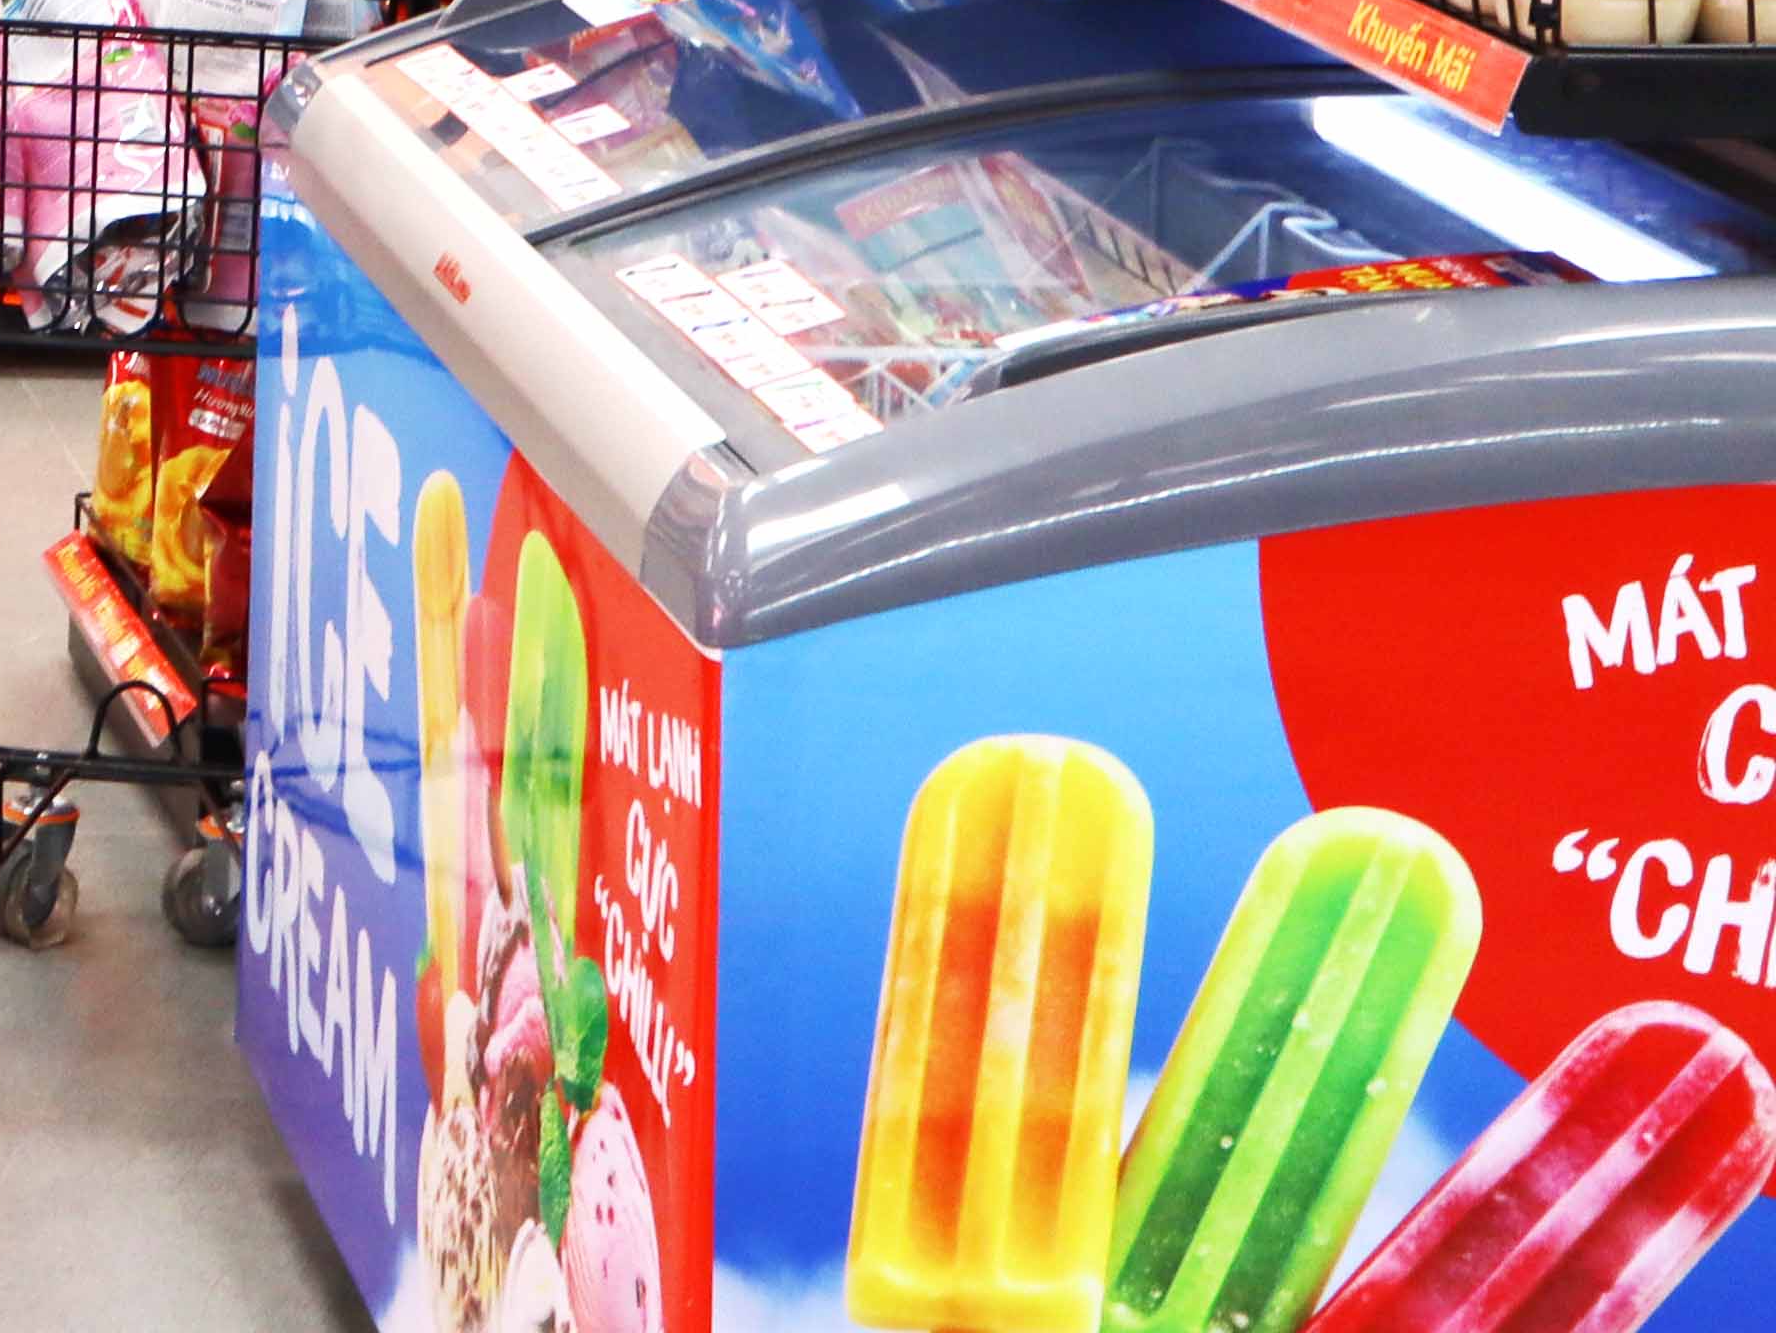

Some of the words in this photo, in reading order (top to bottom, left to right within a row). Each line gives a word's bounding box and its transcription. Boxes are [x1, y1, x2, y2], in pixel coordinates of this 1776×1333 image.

[1425, 43, 1477, 92] Mãi
[1561, 554, 1757, 690] MÁT
[600, 679, 643, 777] MÁT
[247, 750, 398, 1226] CREAM
